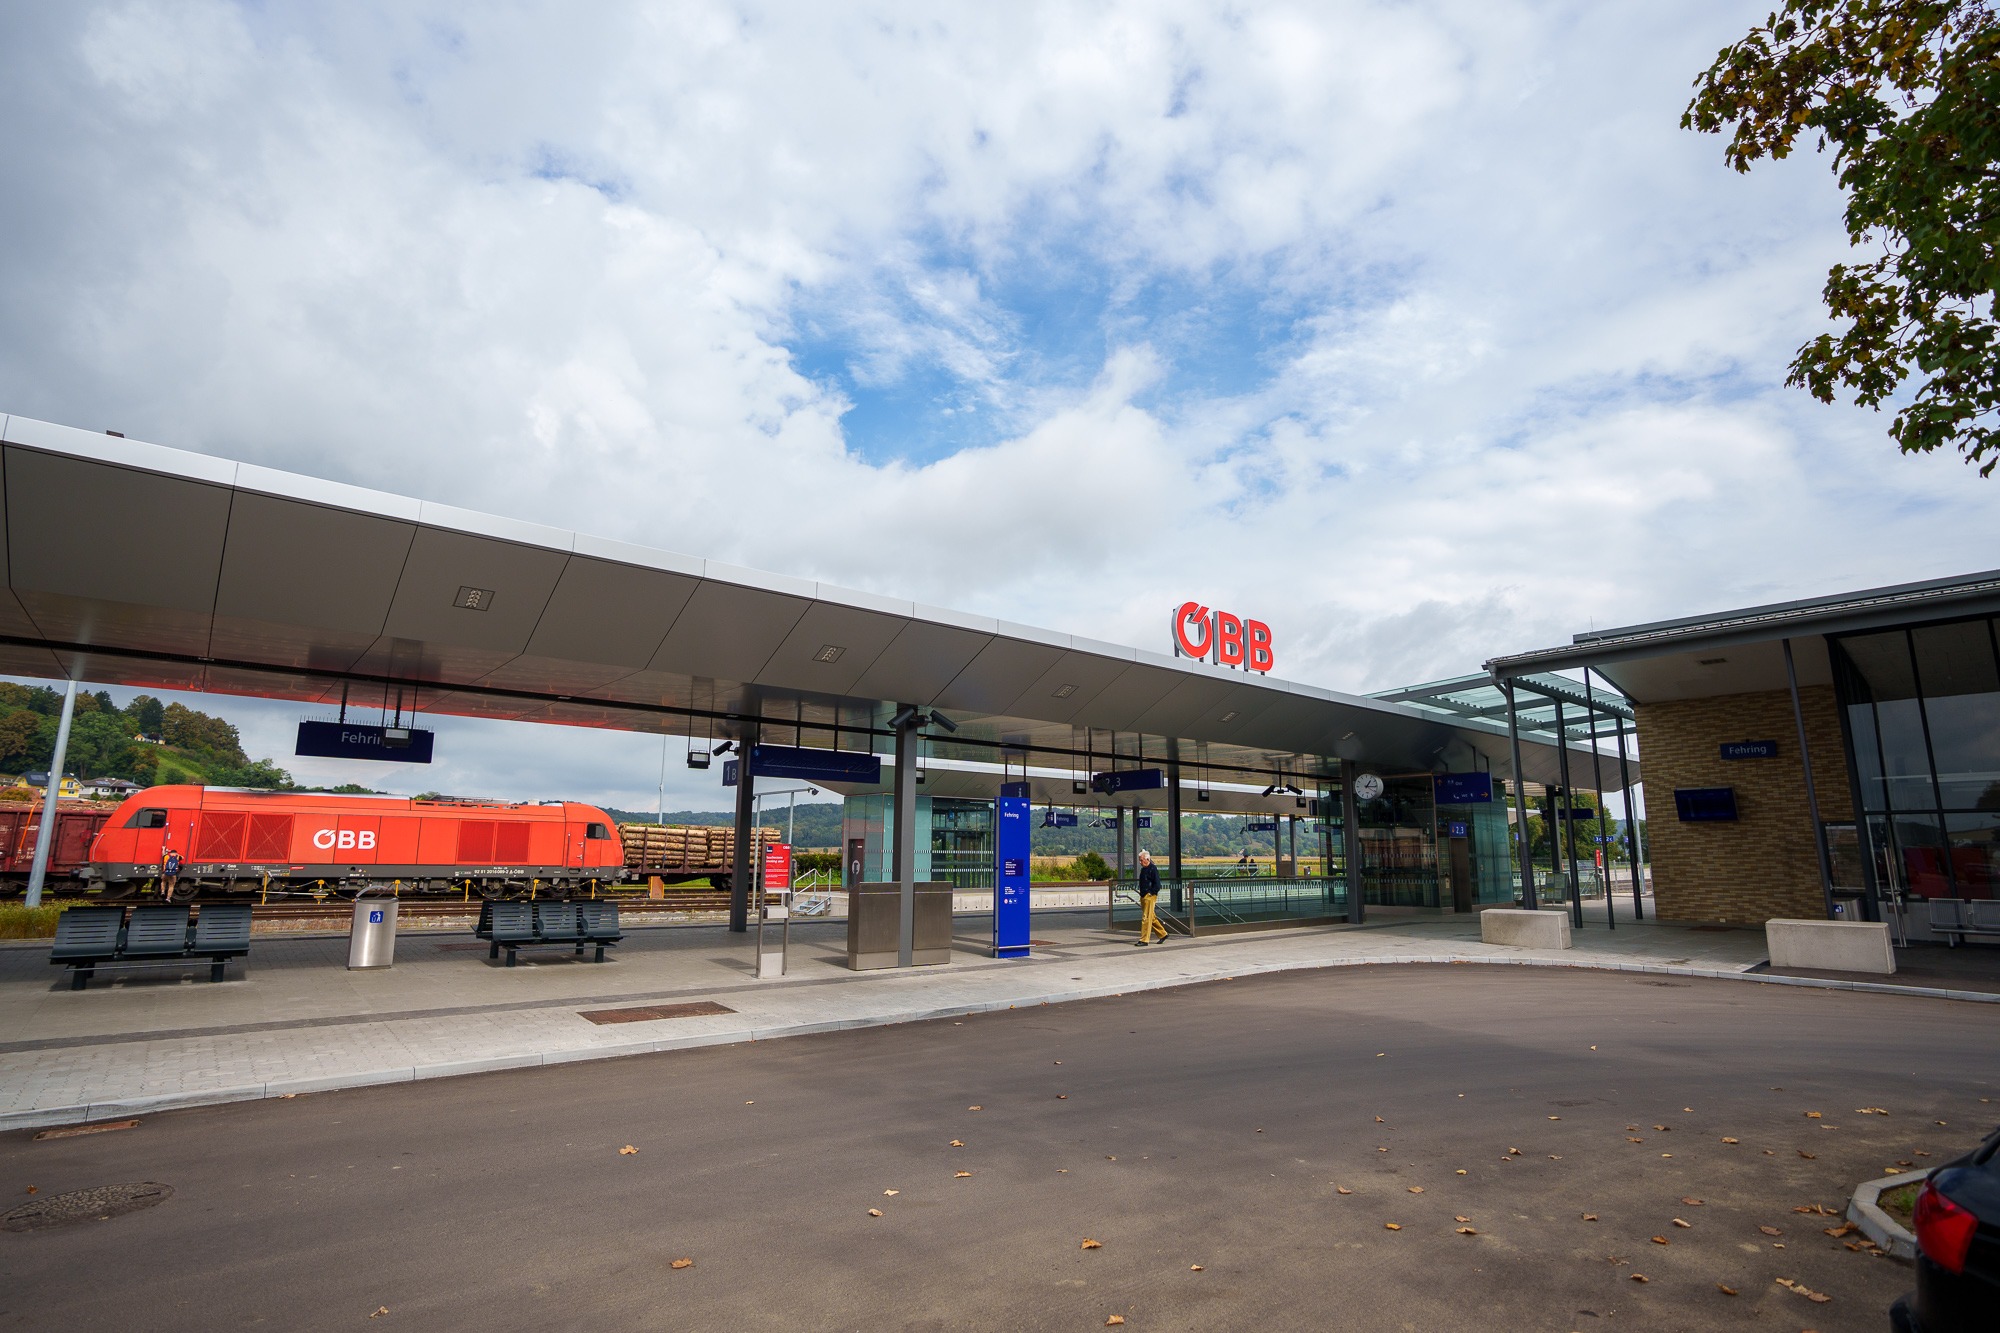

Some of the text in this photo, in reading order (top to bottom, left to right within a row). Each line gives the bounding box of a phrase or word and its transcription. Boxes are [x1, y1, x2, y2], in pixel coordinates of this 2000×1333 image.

[1172, 602, 1273, 671] ÖBB
[341, 731, 381, 745] Fehri
[1729, 746, 1767, 755] Fehring
[1004, 811, 1020, 819] Fehring
[313, 829, 376, 849] ÖBB
